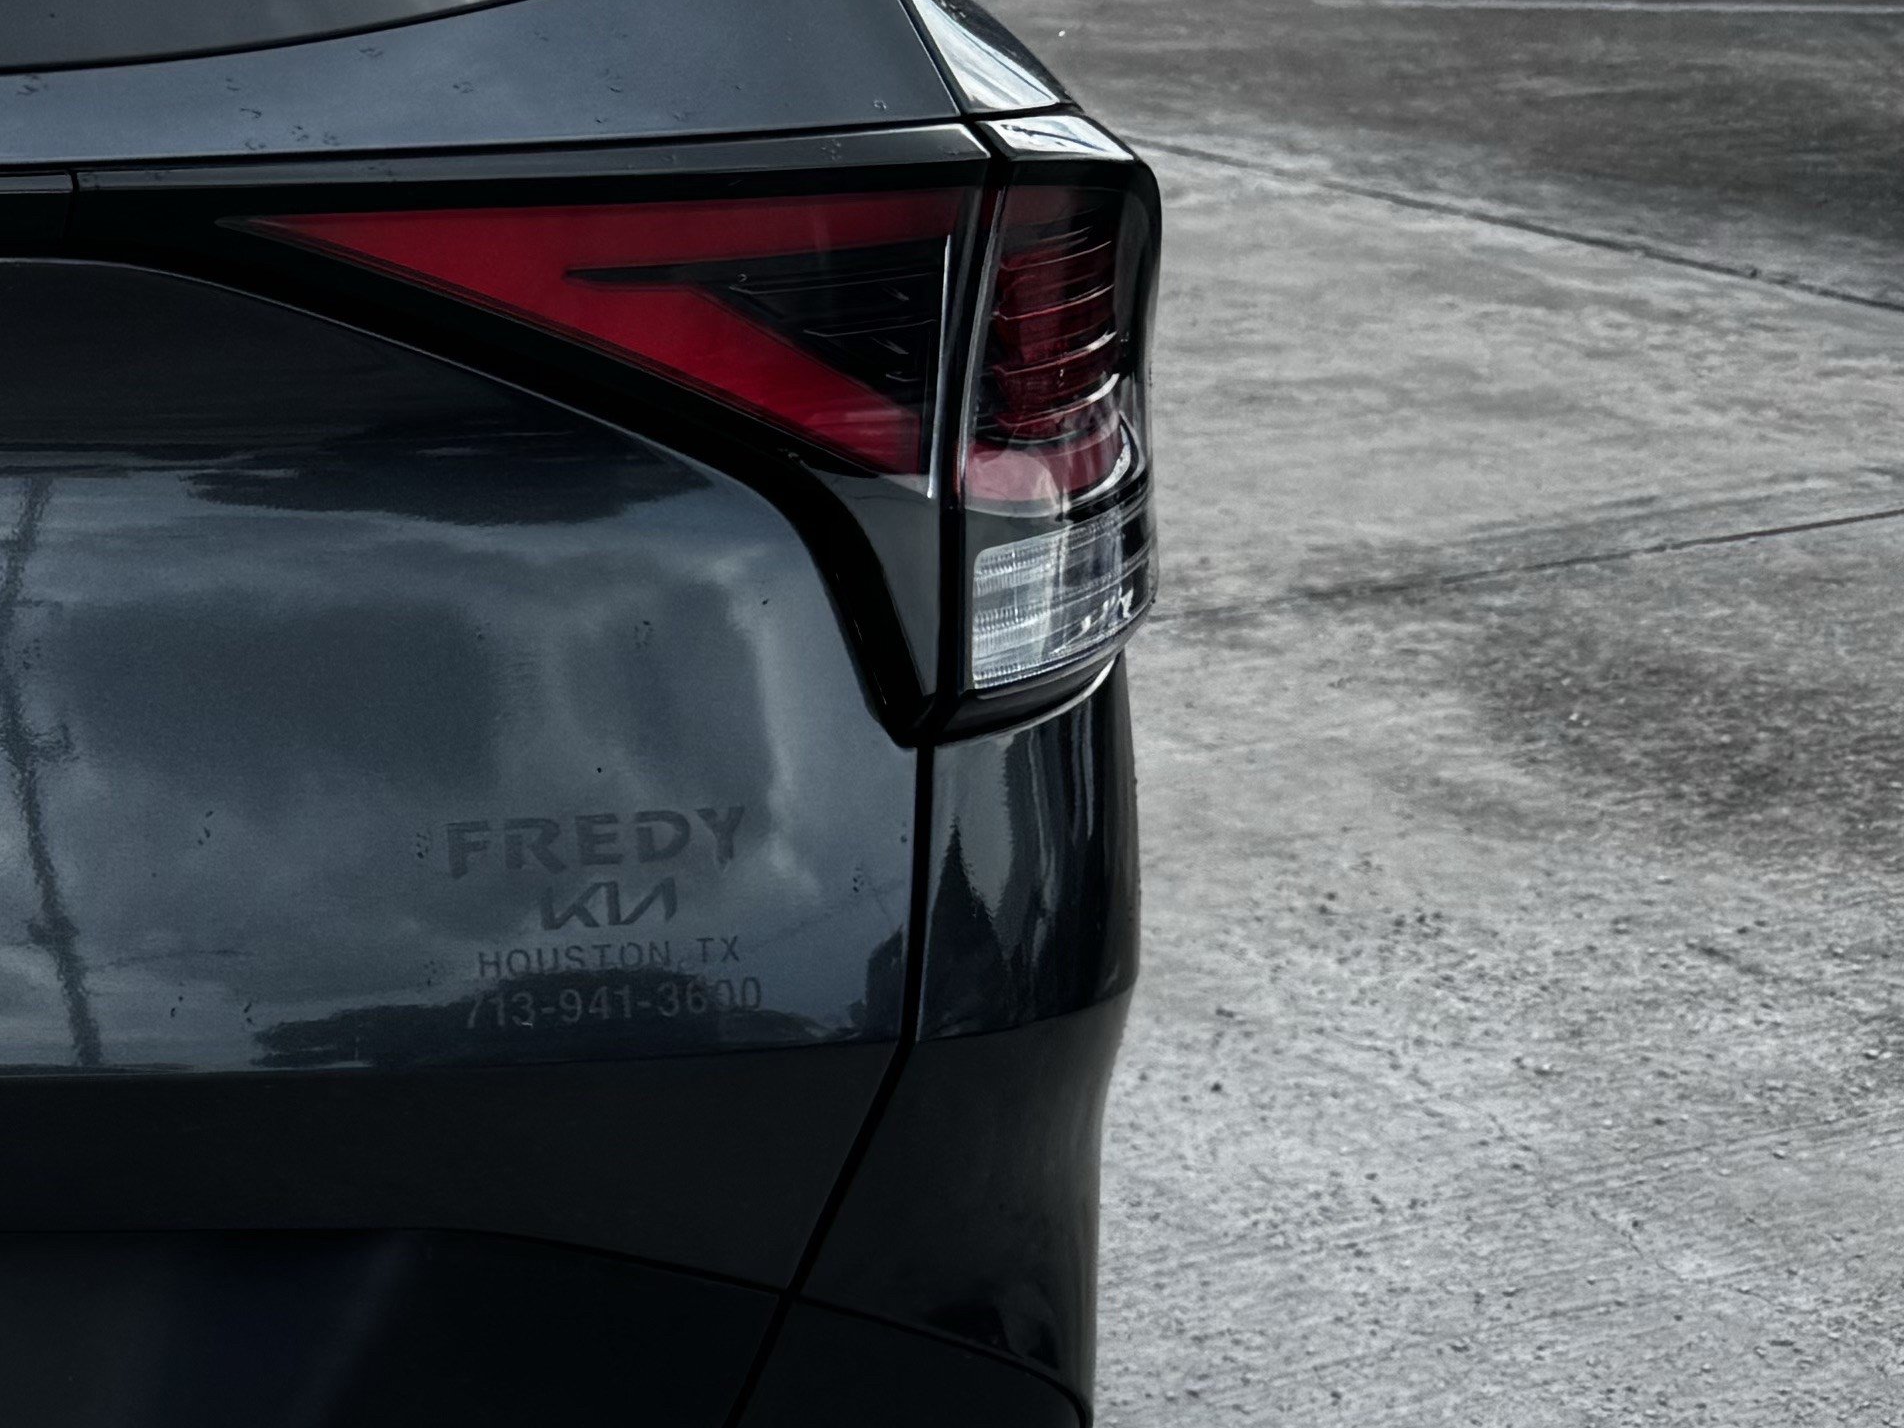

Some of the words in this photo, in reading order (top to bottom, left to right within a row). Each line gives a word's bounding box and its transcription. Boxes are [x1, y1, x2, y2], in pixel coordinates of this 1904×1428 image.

[445, 806, 745, 879] FREDY
[541, 877, 678, 930] KIA
[696, 935, 739, 963] TX
